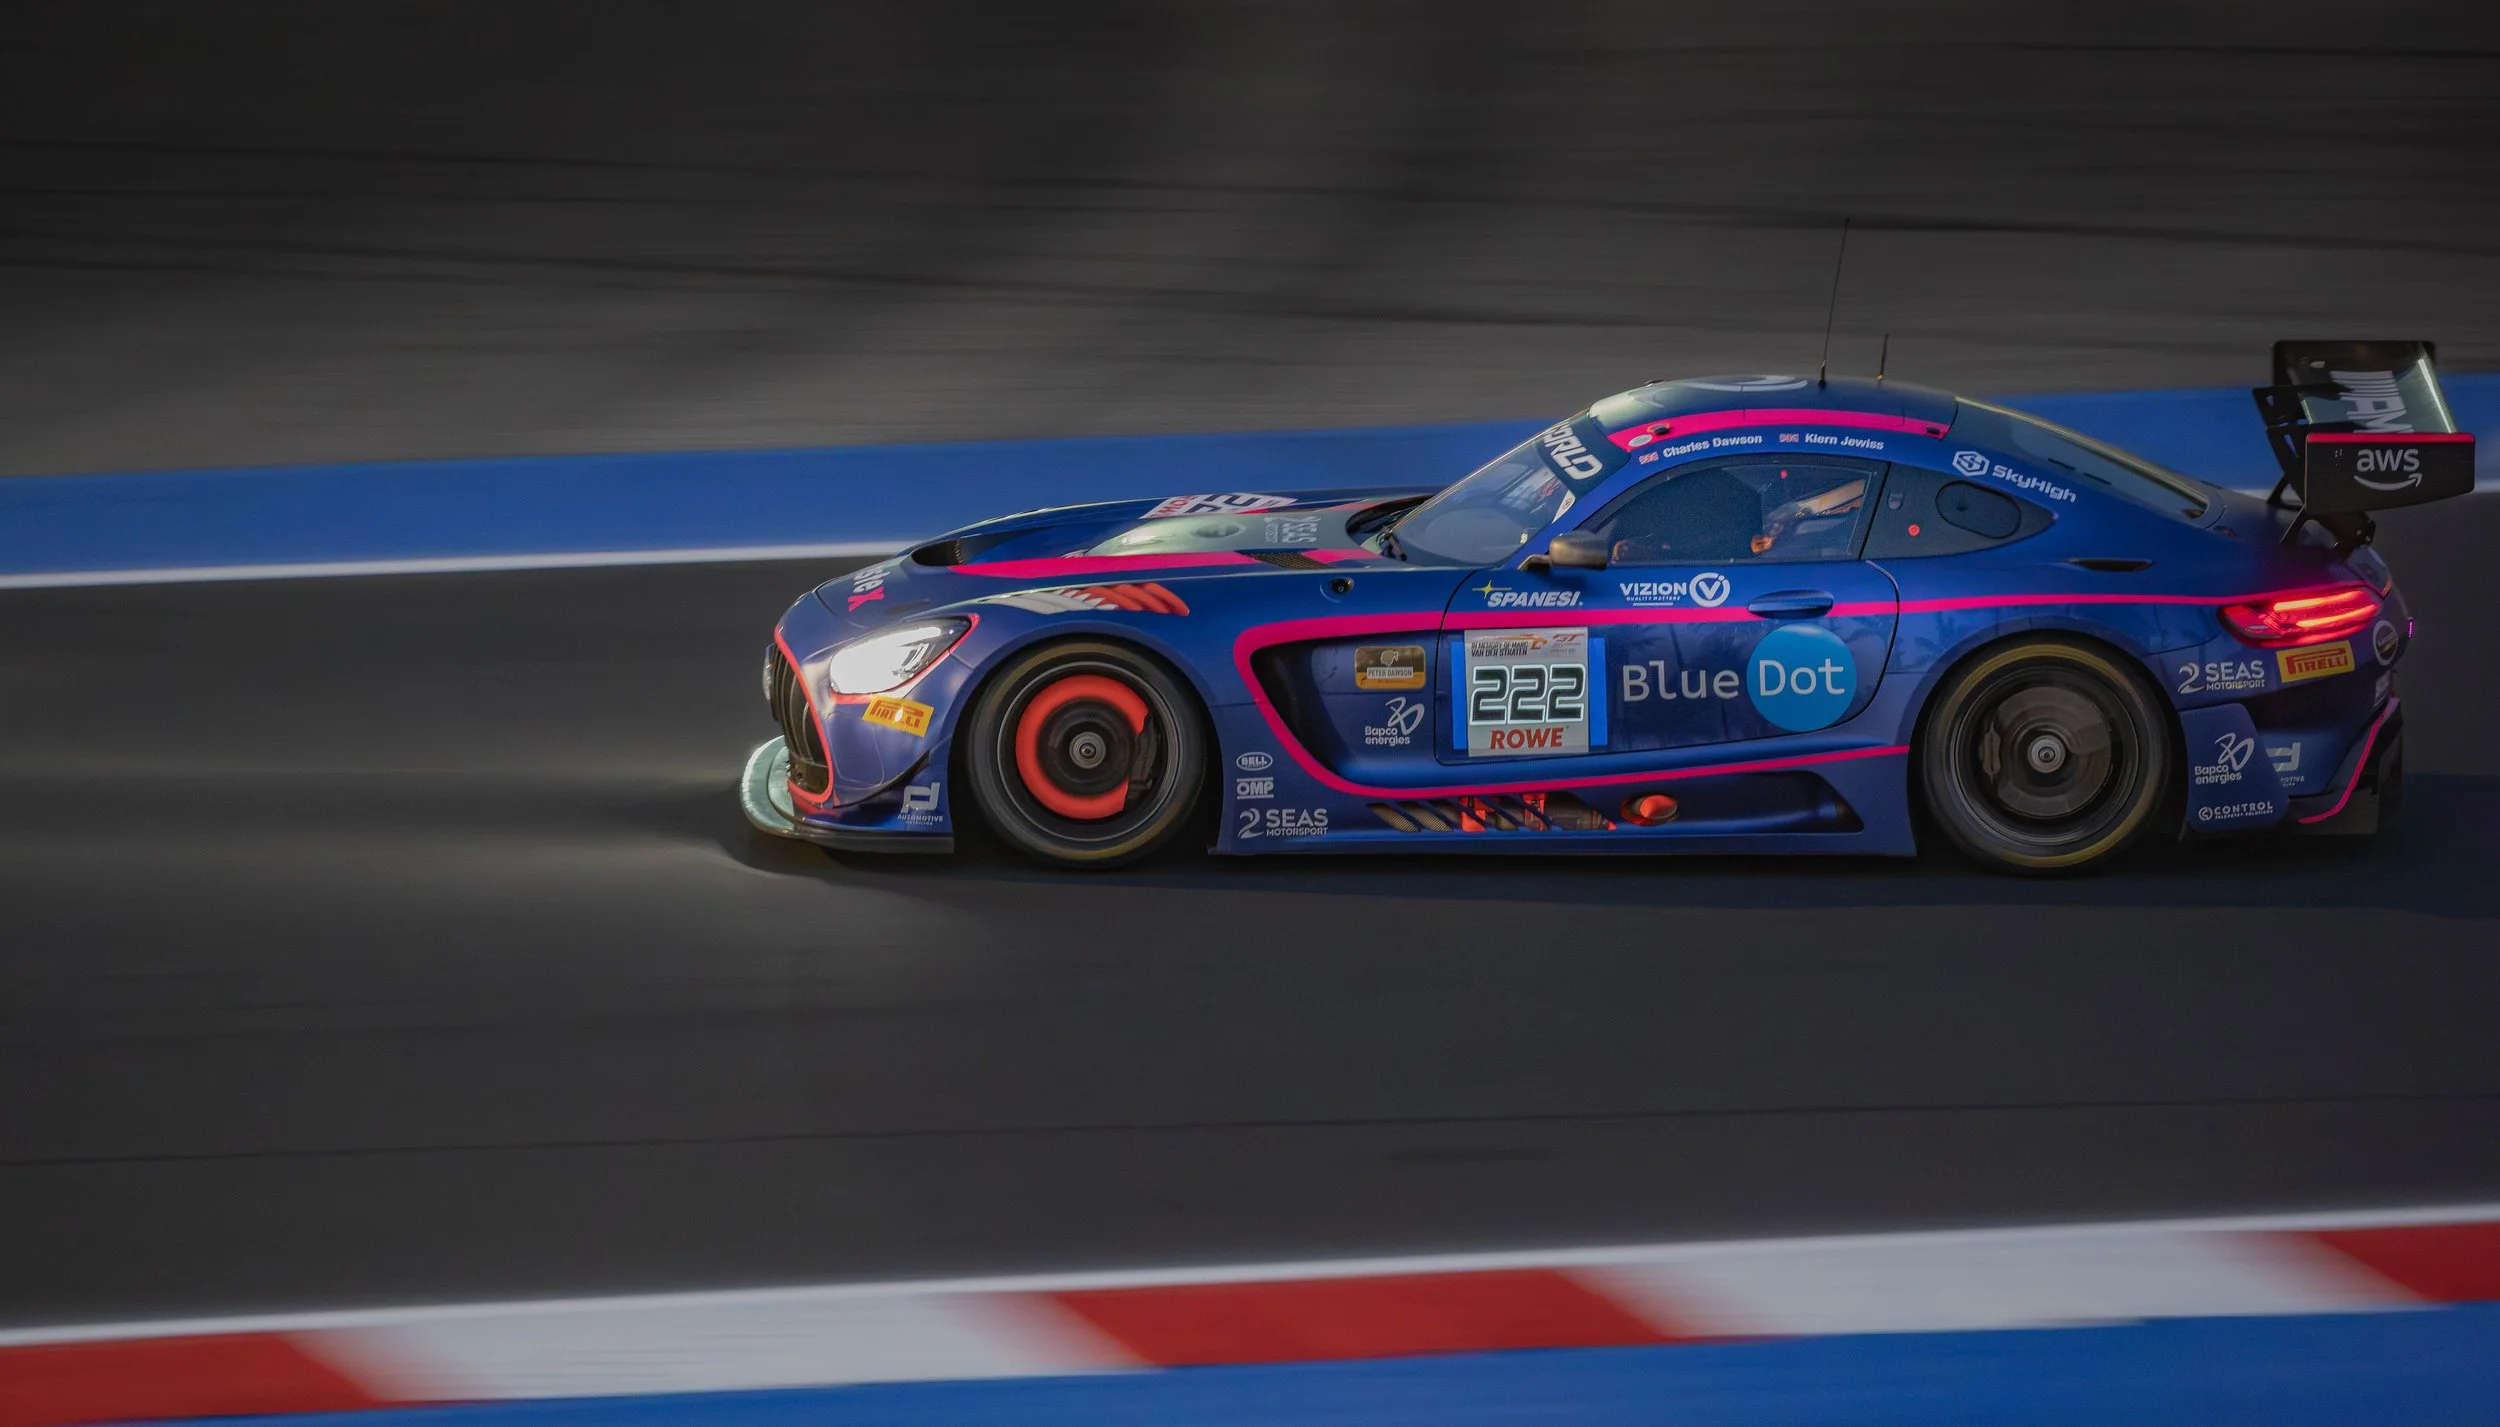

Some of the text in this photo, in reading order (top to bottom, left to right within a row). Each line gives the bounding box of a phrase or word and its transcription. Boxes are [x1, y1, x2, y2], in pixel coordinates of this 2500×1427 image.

[1663, 434, 1763, 458] Charles Dawson
[1805, 433, 1884, 450] Kiern Jewiss
[2356, 448, 2420, 472] aws
[1992, 464, 2077, 503] SkyHigh
[1619, 582, 1687, 596] VIZION
[1471, 646, 1528, 657] VAN DER STRATEN
[2285, 647, 2348, 675] PIRELLI
[1368, 668, 1412, 677] PETER DAWSON
[2205, 660, 2265, 682] SEAS
[1622, 658, 1846, 702] Blue Dot
[2206, 679, 2265, 691] MOTORSPORT
[1469, 664, 1587, 726] 222
[870, 699, 925, 729] PIRELI
[1364, 726, 1398, 736] Bapco
[1490, 727, 1564, 749] ROWE
[1364, 737, 1411, 747] energies
[1241, 757, 1268, 767] BELL
[2194, 764, 2229, 777] Bapco
[2195, 772, 2242, 785] energies
[1236, 780, 1274, 796] OMP
[2213, 800, 2273, 815] CONTROL
[897, 814, 944, 823] AUTOMOTIVE
[1265, 808, 1329, 828] SEAS
[1266, 827, 1328, 837] MOTORSPORT
